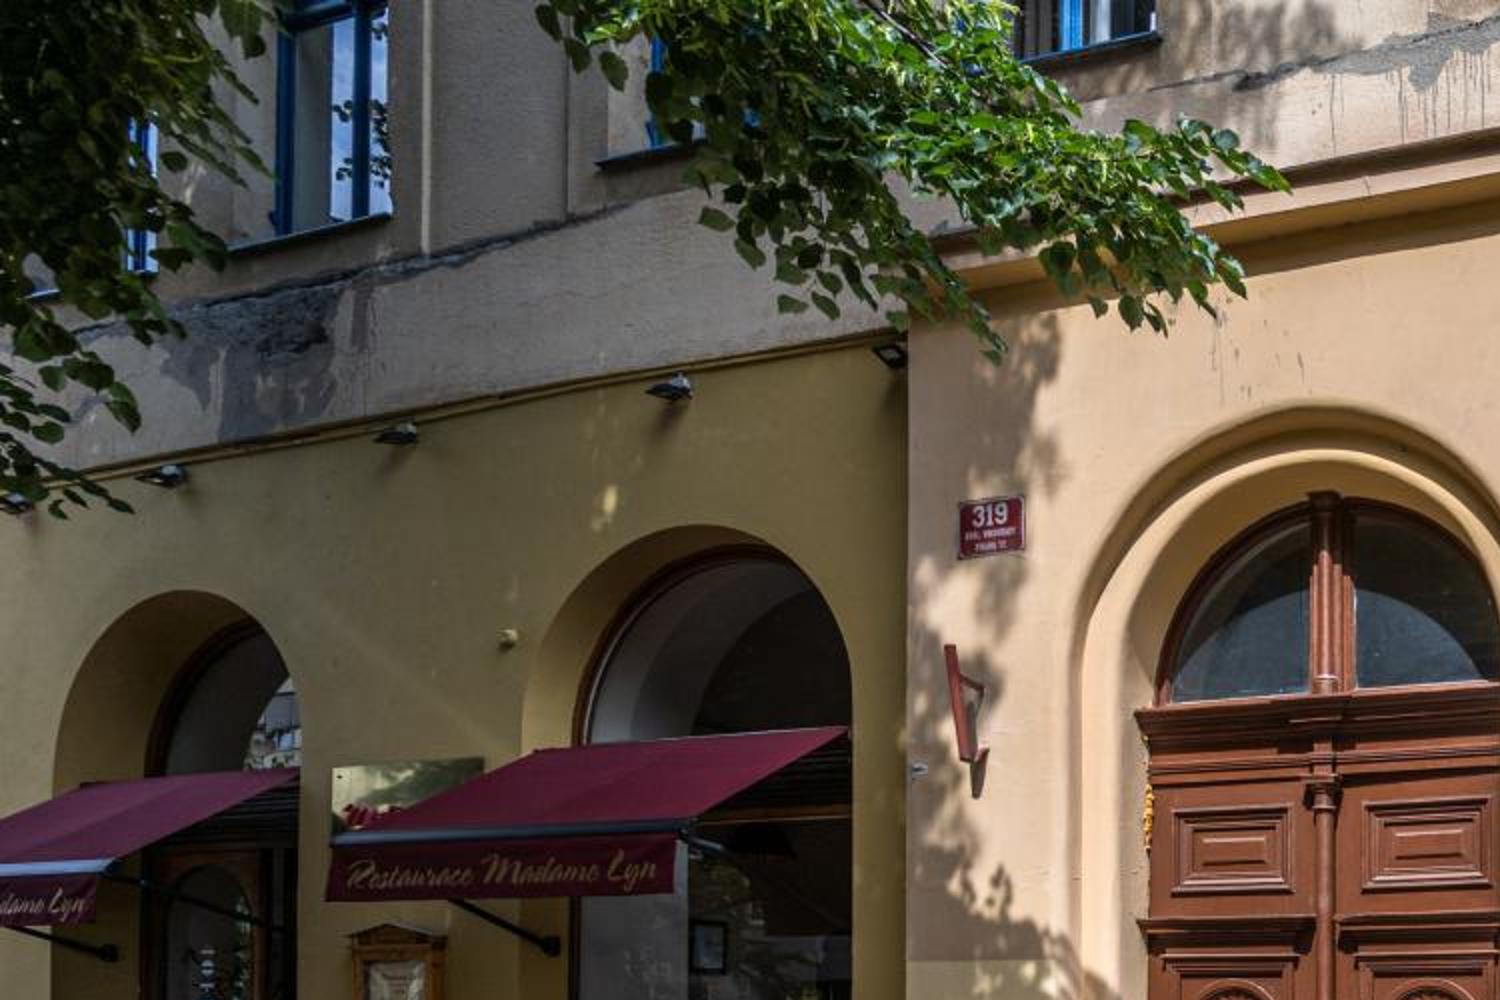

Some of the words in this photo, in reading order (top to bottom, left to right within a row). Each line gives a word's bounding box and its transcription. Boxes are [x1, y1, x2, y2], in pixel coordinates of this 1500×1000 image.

[970, 501, 1009, 529] 319
[347, 858, 473, 890] Restaurace
[480, 852, 600, 885] Madame
[607, 848, 657, 892] Lyn
[48, 886, 84, 923] Lyn
